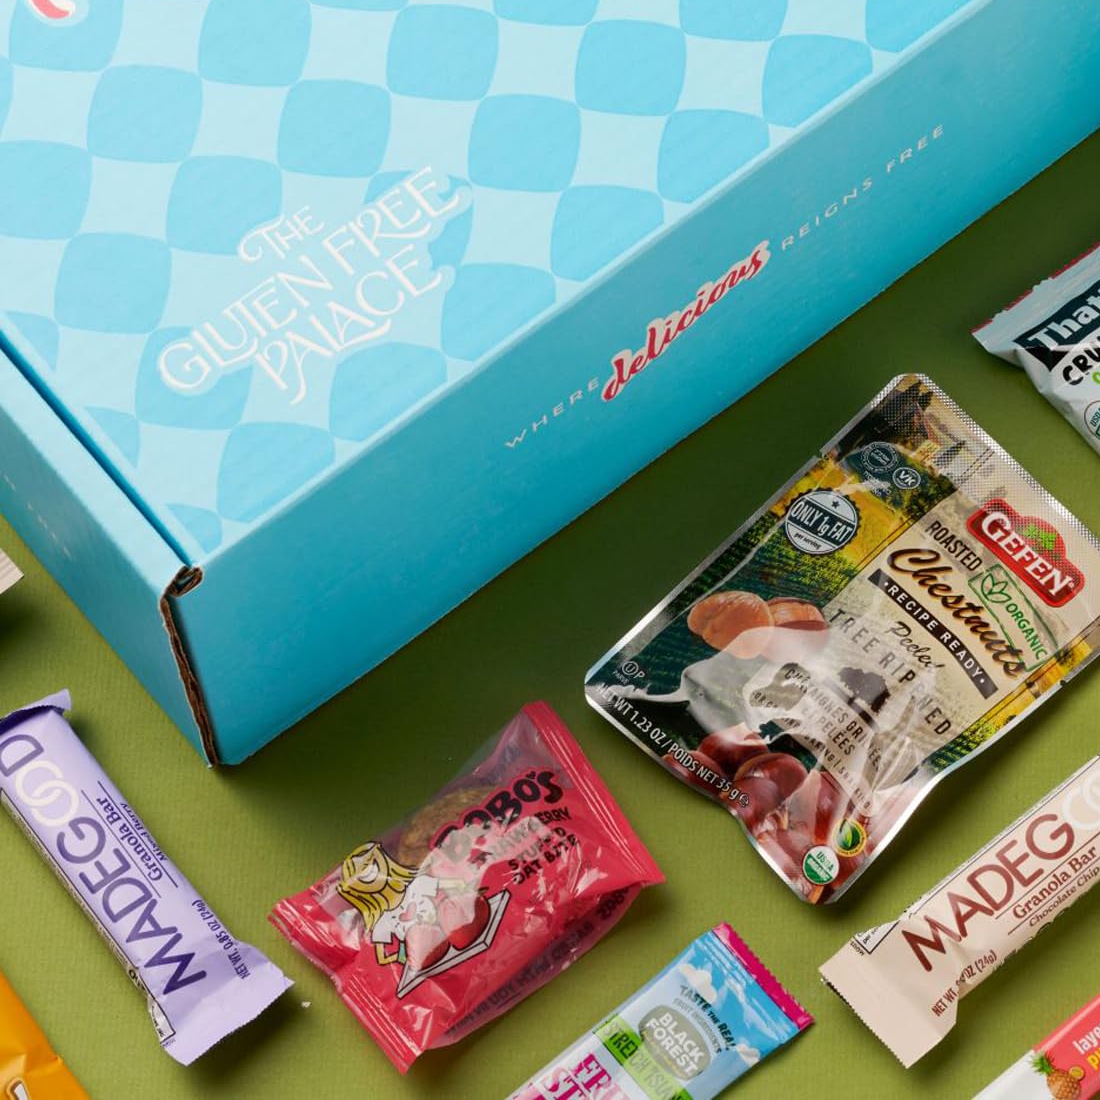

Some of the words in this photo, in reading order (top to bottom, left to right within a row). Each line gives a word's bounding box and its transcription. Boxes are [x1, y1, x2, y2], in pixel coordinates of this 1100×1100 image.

[238, 206, 326, 265] THE
[157, 266, 332, 396] GLUTEN
[325, 166, 470, 284] FREE
[504, 376, 600, 449] WHERE
[601, 240, 771, 403] delicious
[781, 178, 873, 251] REIGNS
[886, 125, 945, 173] FREE
[255, 242, 456, 404] PALACE
[791, 502, 819, 528] ONLY
[820, 517, 831, 536] 1g
[830, 523, 852, 542] FAT
[926, 520, 982, 571] ROASTED
[981, 511, 1073, 597] GEFEN
[887, 548, 1026, 678] Chestnuts
[887, 583, 936, 631] RECIPE
[940, 632, 982, 677] READY
[1006, 603, 1048, 661] ORGANIC
[615, 697, 633, 715] WT
[630, 710, 650, 733] 1.23
[649, 727, 667, 745] OZ
[669, 742, 699, 773] POIDS
[698, 766, 719, 785] NET
[716, 777, 731, 792] 35
[730, 788, 739, 800] g
[96, 797, 121, 824] Bar
[0, 734, 207, 995] MADEGOOD
[119, 823, 164, 882] Granola
[1011, 869, 1073, 920] Granola
[1068, 845, 1098, 876] Bar
[1029, 886, 1077, 928] Chocolate
[1076, 865, 1100, 889] Chip
[645, 1018, 701, 1075] FOREST
[658, 1012, 705, 1060] BLACK
